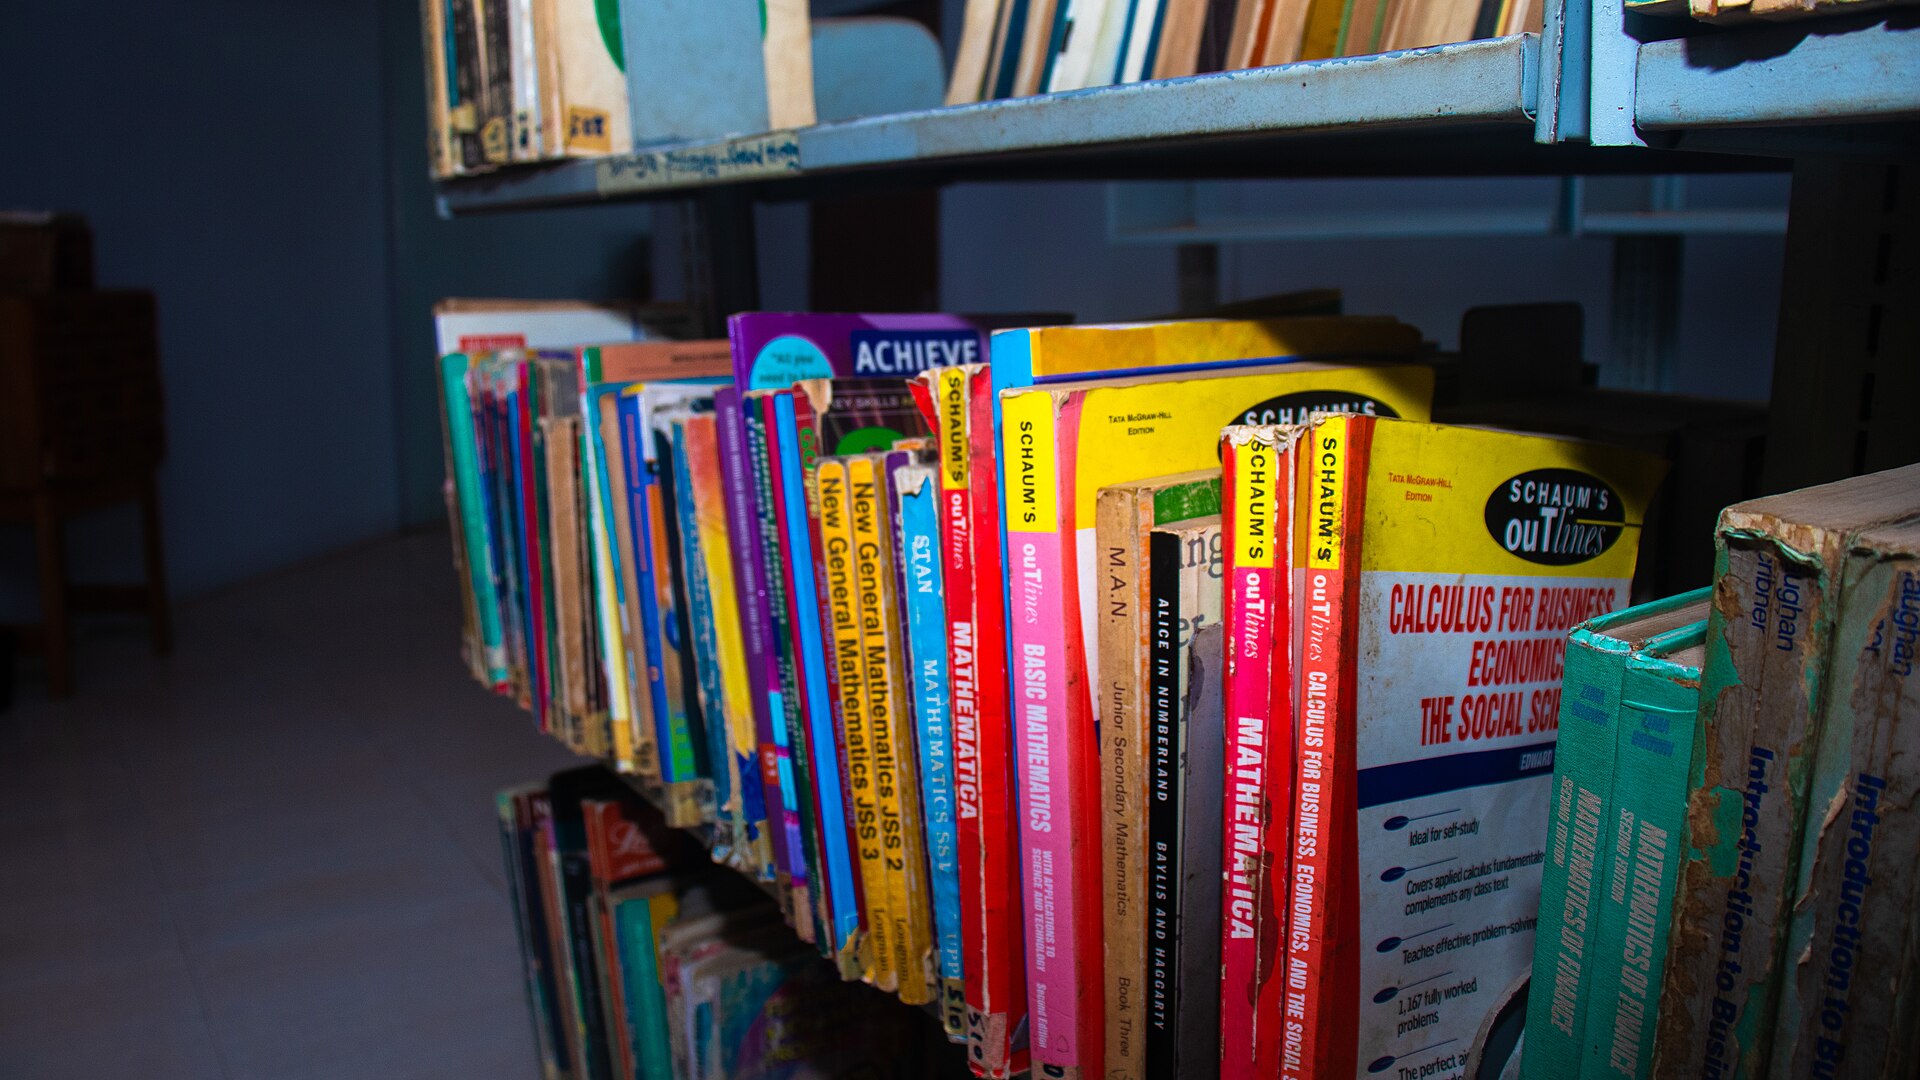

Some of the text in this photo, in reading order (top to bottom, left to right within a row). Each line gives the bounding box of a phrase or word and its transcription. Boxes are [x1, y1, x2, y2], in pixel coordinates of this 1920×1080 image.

[856, 339, 978, 373] ACHIEVE
[948, 376, 968, 570] SCHAUM'S ouTlines
[1510, 479, 1609, 510] SCHAUM'S
[1019, 420, 1043, 624] SCHAUM'S ouTlines
[1245, 438, 1267, 658] SCHAUM'S ouTlines
[1309, 437, 1337, 662] SCHAUM'S ouTlines
[1505, 506, 1607, 556] ouTlines
[1109, 547, 1127, 623] M.A.N.
[1389, 583, 1495, 634] CALCULUS
[1497, 586, 1535, 632] FOR
[822, 478, 879, 860] New General Mathematics JSS 3
[853, 483, 903, 871] New General Mathematics JSS 2
[1156, 598, 1169, 801] ALICE IN NUMBERLAND
[923, 659, 948, 823] MATHEMATICS
[953, 621, 978, 819] MATHEMATICA
[1023, 643, 1051, 833] BASIC MATHEMATICS
[1304, 671, 1328, 747] CALCULUS
[1420, 696, 1455, 746] THE
[1458, 691, 1523, 742] SOCIAL
[1303, 750, 1322, 780] FOR
[1520, 750, 1552, 771] EDWARD
[1112, 682, 1128, 917] Junior Secondary Mathematics
[1230, 717, 1264, 939] MATHEMATICA
[1296, 781, 1321, 859] BUSINESS,
[1409, 818, 1480, 846] Ideal for self-study
[1553, 775, 1574, 868] SECOND EDITION
[1406, 880, 1433, 896] Covers
[1435, 869, 1462, 891] applied
[1463, 861, 1492, 881] calculus
[1611, 808, 1634, 904] SECOND EDITION
[1721, 747, 1774, 949] Introduction
[1828, 772, 1887, 992] Introduction
[1033, 848, 1045, 972] SCIENCE AND TECHNOLOGY
[1043, 850, 1056, 958] WITH APPLICATIONS TO
[1291, 864, 1314, 953] ECONOMICS,
[1405, 876, 1509, 916] complements any class text
[1551, 786, 1602, 1037] MATHEMATICS OF FINANCE
[1154, 841, 1167, 1029] BAYLIS AND HAGGARTY
[1403, 945, 1434, 965] Teaches
[1436, 934, 1471, 955] effective
[1611, 820, 1668, 1080] MATHEMATICS OF FINANCE
[1716, 955, 1743, 991] to
[1036, 982, 1048, 1016] Second
[1118, 977, 1130, 1011] Book
[1286, 993, 1305, 1019] THE
[1288, 959, 1308, 989] AND
[1398, 977, 1477, 1016] 1,167 fully worked
[1119, 1016, 1132, 1057] Three
[1283, 1021, 1303, 1071] SOCIAL
[1398, 1010, 1439, 1038] problems
[1821, 999, 1850, 1031] to
[1398, 1066, 1418, 1080] The
[1420, 1054, 1457, 1080] perfect
